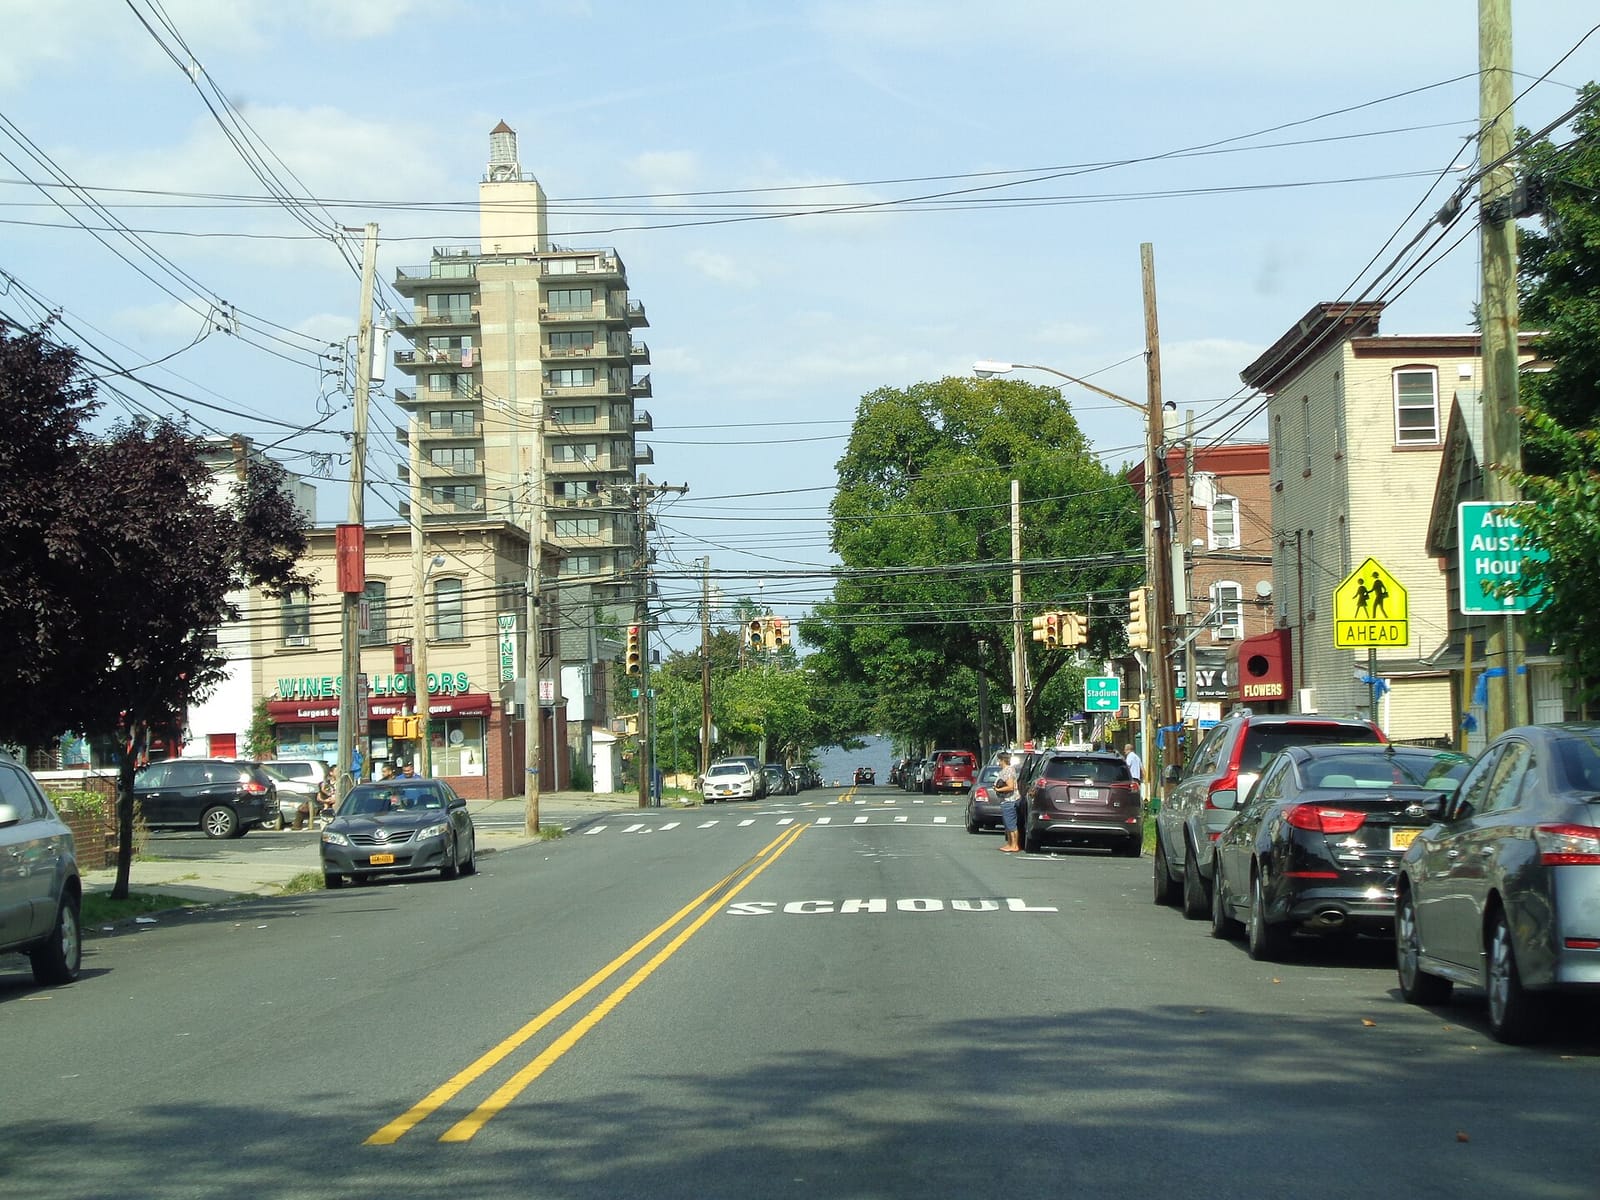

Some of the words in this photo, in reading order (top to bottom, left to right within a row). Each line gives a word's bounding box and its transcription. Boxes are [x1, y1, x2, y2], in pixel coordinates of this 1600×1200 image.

[1475, 557, 1521, 575] Hou
[1346, 625, 1400, 641] AHEAD
[498, 616, 515, 682] WINES
[1087, 689, 1118, 698] Stadium
[1244, 683, 1282, 698] FLOWERS
[297, 708, 329, 718] Largest
